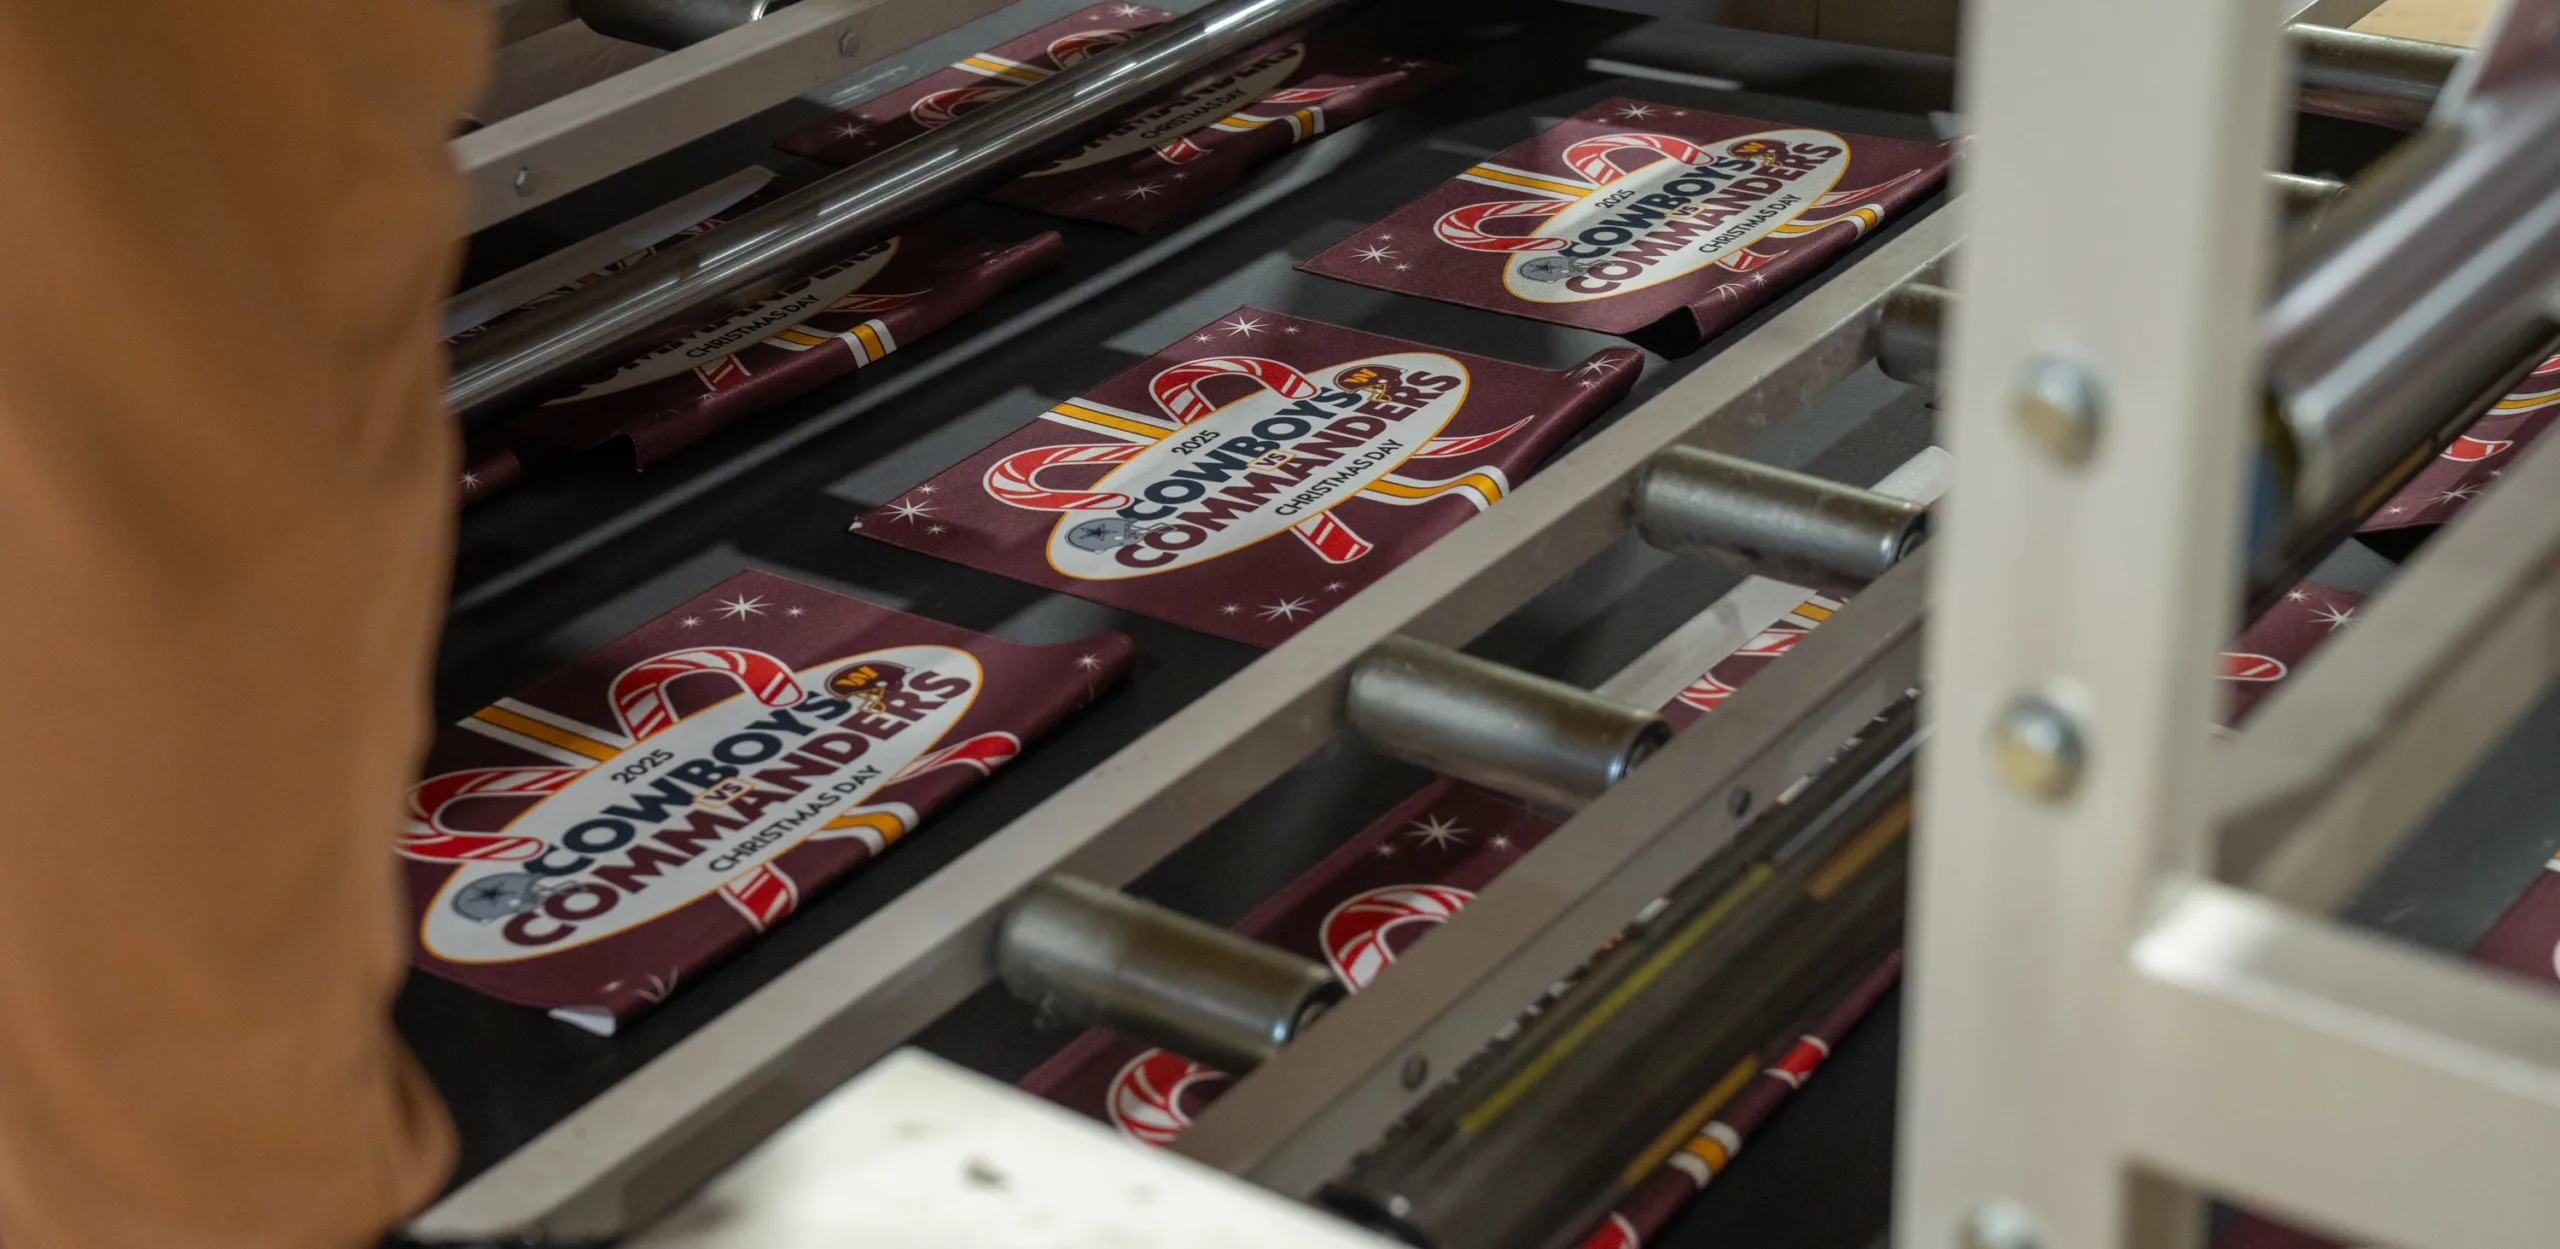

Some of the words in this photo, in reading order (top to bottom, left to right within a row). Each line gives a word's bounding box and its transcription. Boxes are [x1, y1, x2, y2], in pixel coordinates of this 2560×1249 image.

[1140, 100, 1219, 140] CHRISTMAS
[1215, 88, 1248, 112] DAY
[1557, 156, 1756, 259] COWBOYS
[1565, 143, 1842, 294] COMMANDERS
[1595, 189, 1635, 209] 2025
[1672, 205, 1700, 217] VS
[1698, 208, 1778, 254] CHRISTMAS
[1774, 194, 1802, 212] DAY
[686, 306, 787, 359] CHRISTMAS
[784, 293, 821, 317] DAY
[1115, 370, 1461, 569] COMMANDERS
[1116, 386, 1363, 521] COWBOYS
[1171, 430, 1220, 456] 2025
[1255, 452, 1288, 468] VS
[1275, 455, 1375, 516] CHRISTMAS
[1369, 438, 1404, 462] DAY
[523, 690, 852, 877] COWBOYS
[610, 748, 675, 785] 2025
[703, 781, 745, 803] VS
[502, 670, 972, 946] COMMANDERS
[708, 789, 840, 873] CHRISTMAS
[838, 764, 883, 796] DAY
